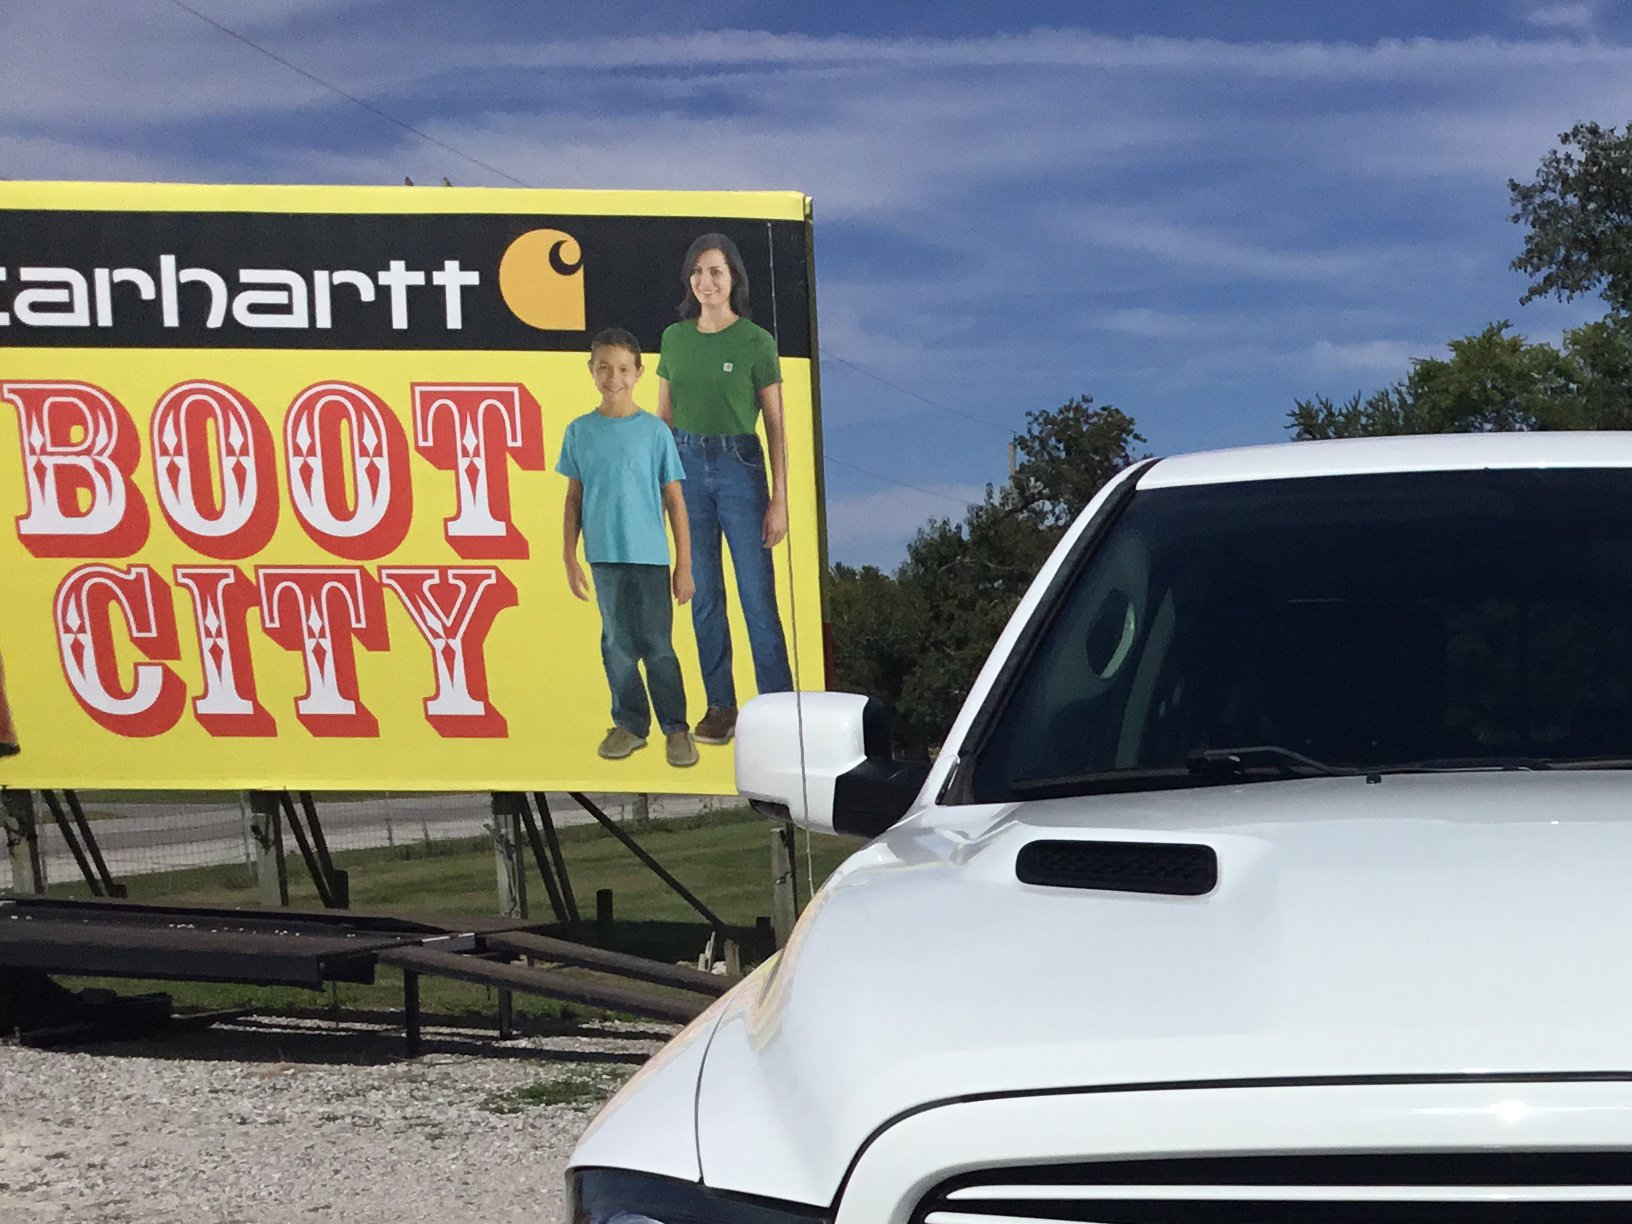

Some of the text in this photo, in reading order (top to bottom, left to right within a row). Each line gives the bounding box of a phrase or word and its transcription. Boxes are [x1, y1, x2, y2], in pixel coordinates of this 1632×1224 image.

[0, 254, 480, 330] arhartt
[1, 380, 545, 560] BOOT
[53, 564, 519, 738] CITY
